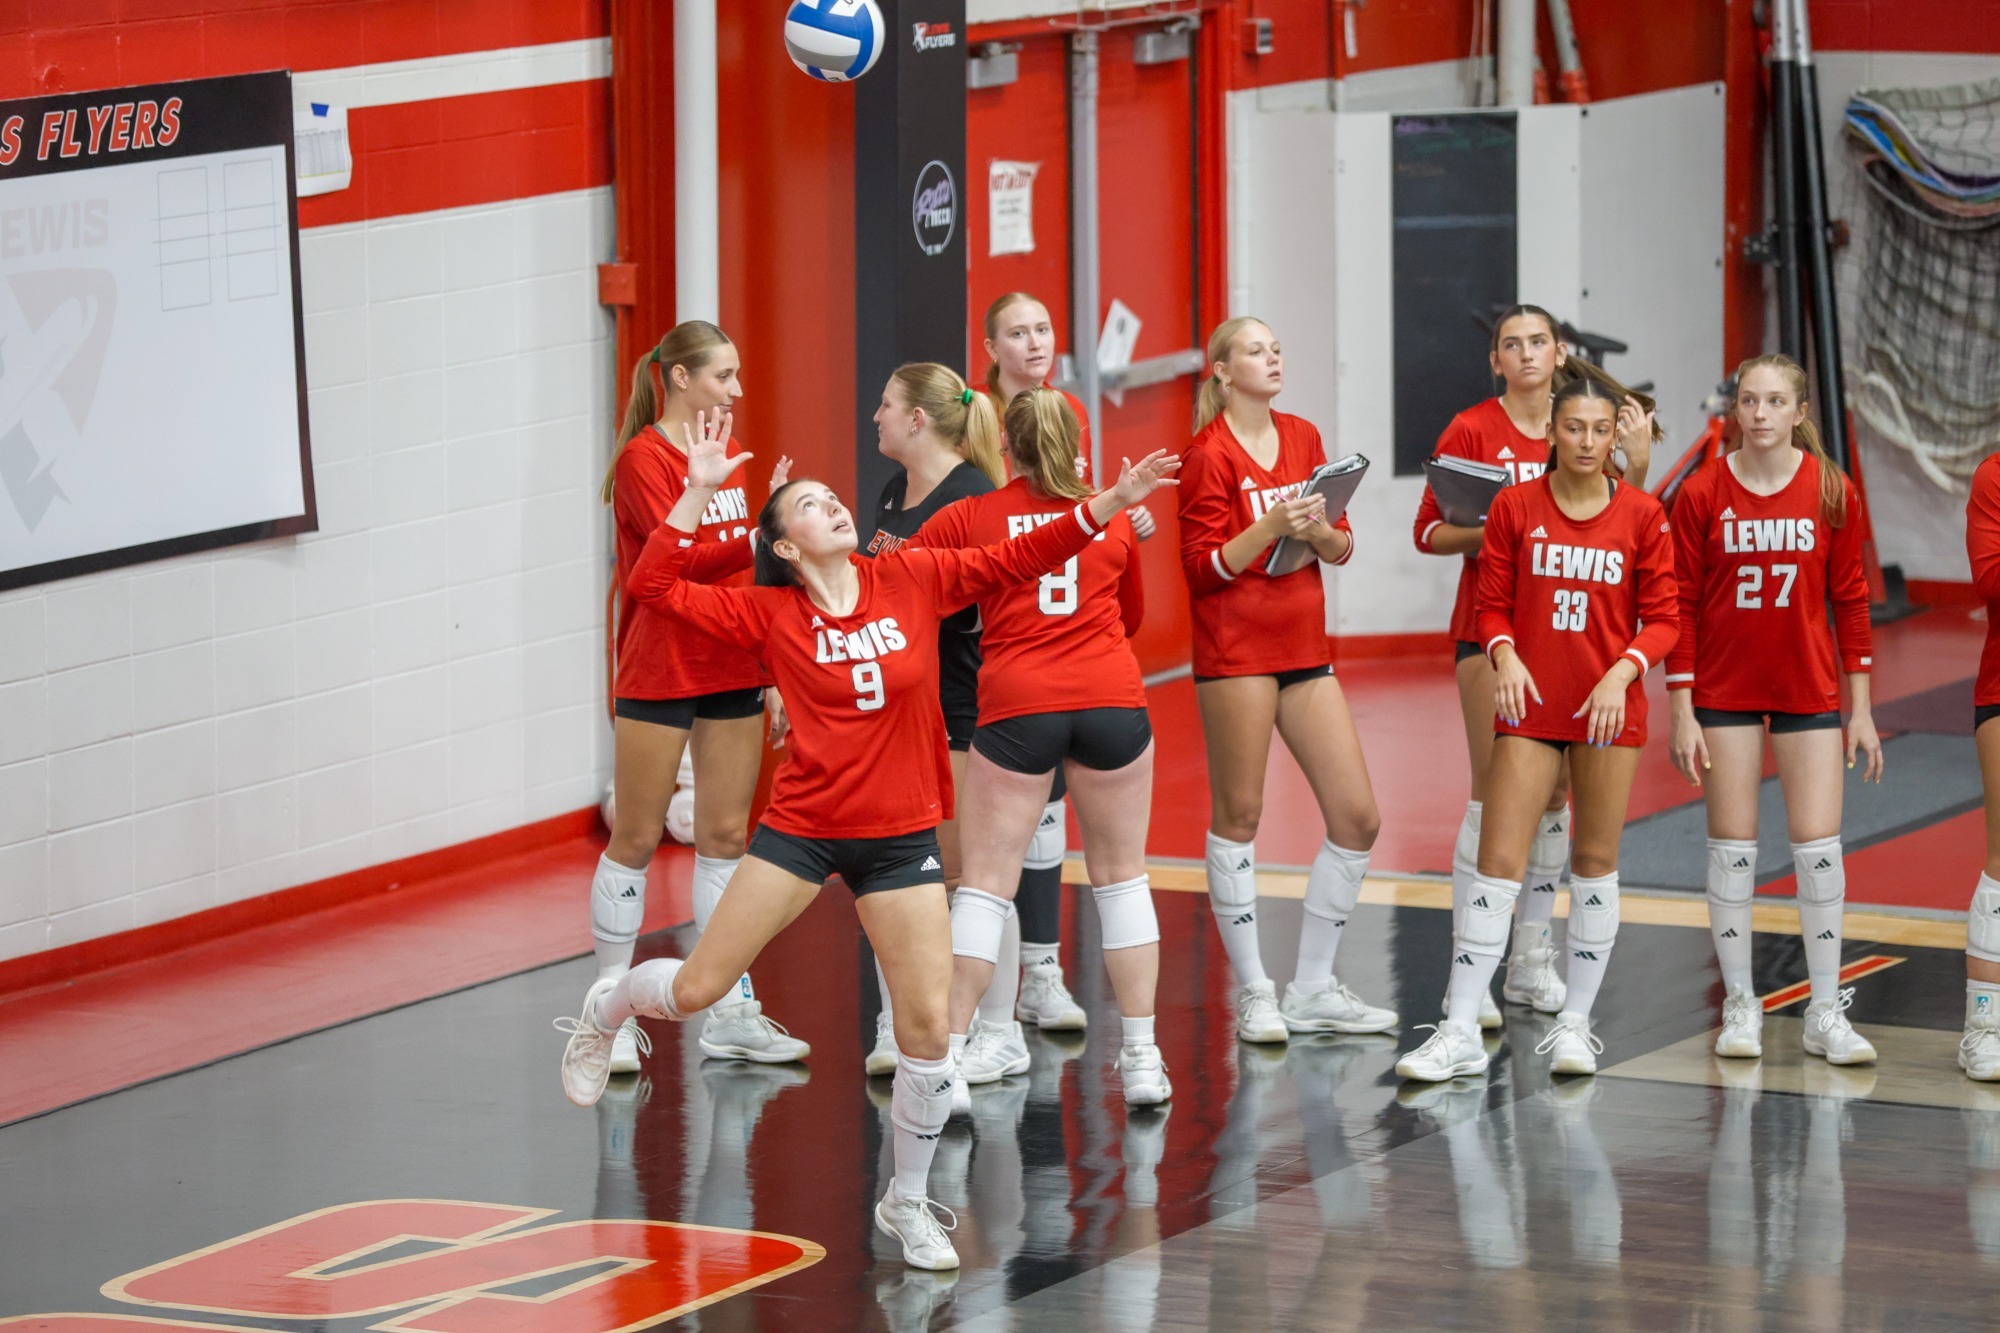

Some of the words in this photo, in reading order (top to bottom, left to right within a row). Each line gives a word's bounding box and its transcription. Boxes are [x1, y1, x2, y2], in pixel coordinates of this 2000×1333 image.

[924, 33, 956, 49] FLYERS
[37, 96, 183, 161] FLYERS
[1723, 517, 1815, 553] LEWIS
[1038, 553, 1079, 615] 8
[1531, 542, 1625, 586] LEWIS
[1736, 563, 1799, 610] 27
[1551, 588, 1589, 633] 33
[816, 616, 907, 664] LEWIS
[851, 660, 886, 712] 9
